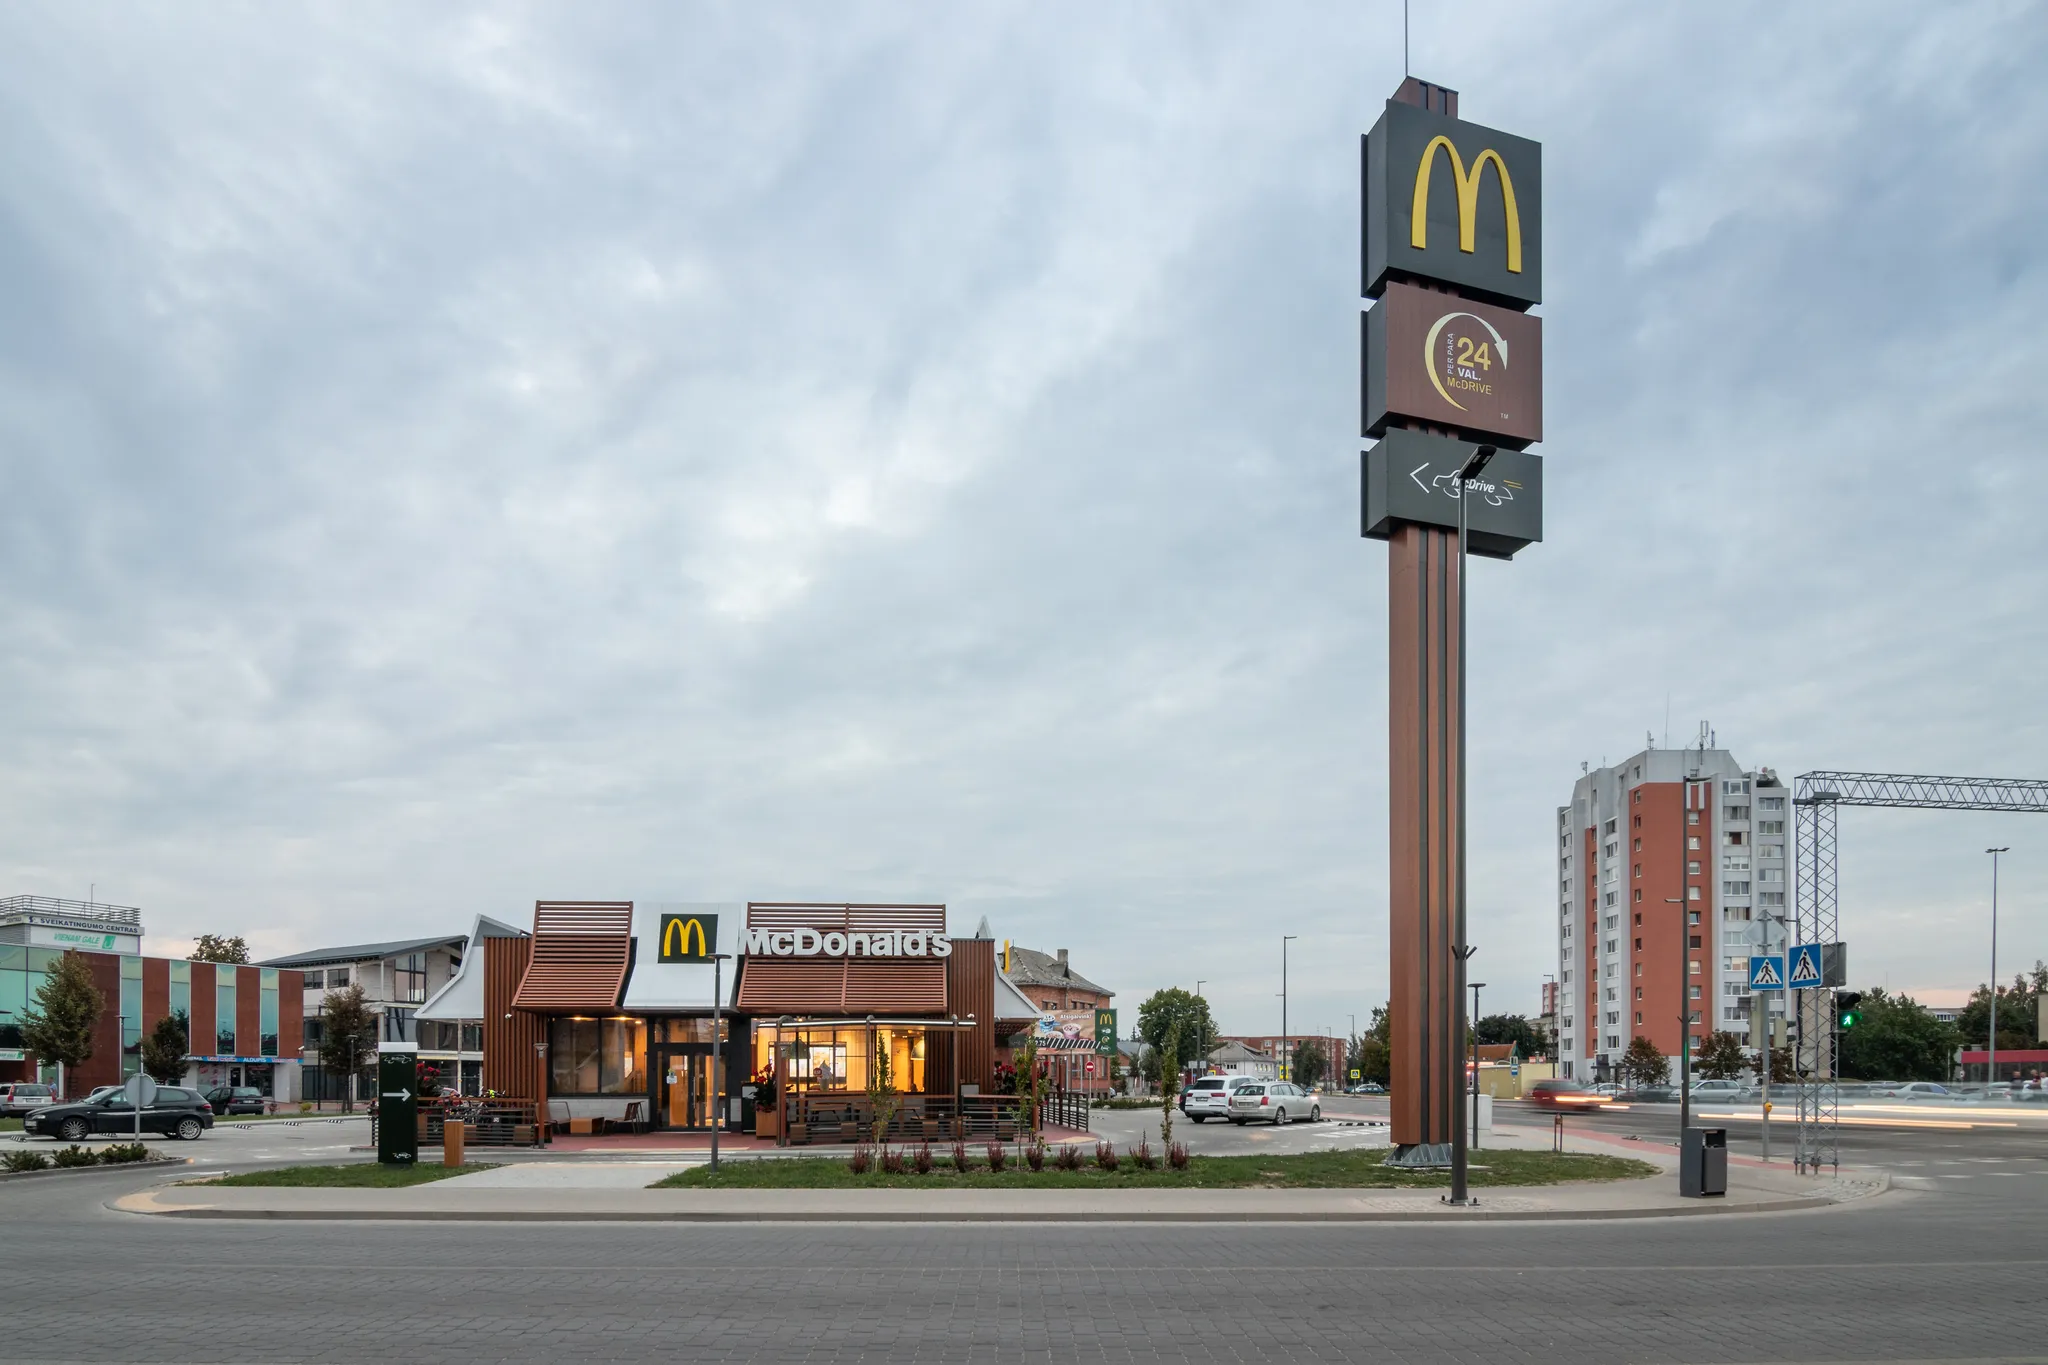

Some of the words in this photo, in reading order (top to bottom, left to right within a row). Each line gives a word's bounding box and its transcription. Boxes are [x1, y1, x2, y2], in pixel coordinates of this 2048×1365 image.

[1456, 337, 1491, 371] 24
[1457, 367, 1481, 381] VAL.
[1447, 376, 1492, 395] McDRIVE
[40, 917, 104, 930] SVEIKATINGUMO
[106, 924, 138, 934] CENTRAS
[737, 928, 953, 957] McDonald's
